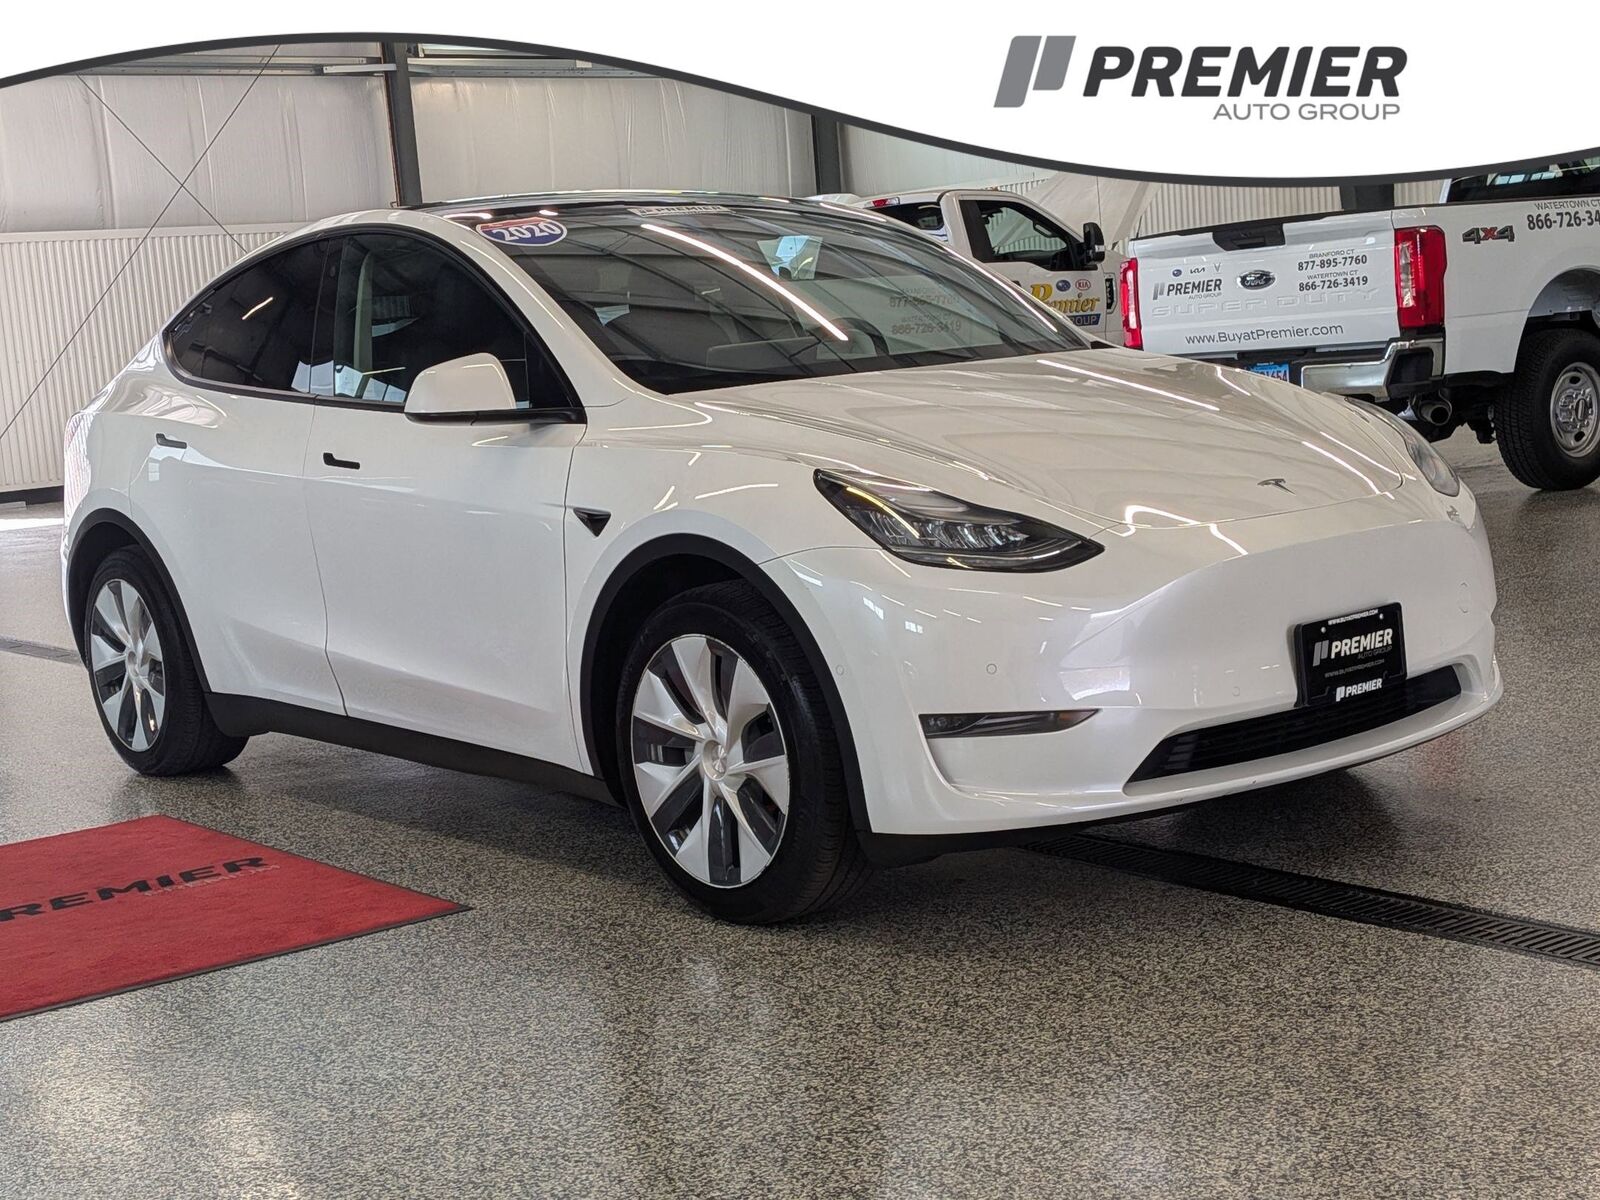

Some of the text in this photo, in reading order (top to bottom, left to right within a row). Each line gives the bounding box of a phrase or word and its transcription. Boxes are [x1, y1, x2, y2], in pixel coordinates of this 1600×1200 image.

[1534, 200, 1590, 211] WATERTOWN
[492, 221, 562, 241] 2020
[1309, 250, 1345, 259] BRANFORD
[1298, 255, 1368, 271] 877-895-7760
[1307, 271, 1349, 280] WATERTOWN
[1167, 279, 1223, 296] PREMIER
[1299, 276, 1369, 292] 866-726-3419
[1277, 287, 1380, 306] DUTY
[1185, 324, 1344, 344] www.BuyatPremier.com
[1331, 628, 1393, 659] PREMIER
[1357, 651, 1373, 659] AUTO
[1345, 678, 1383, 697] PREMIER
